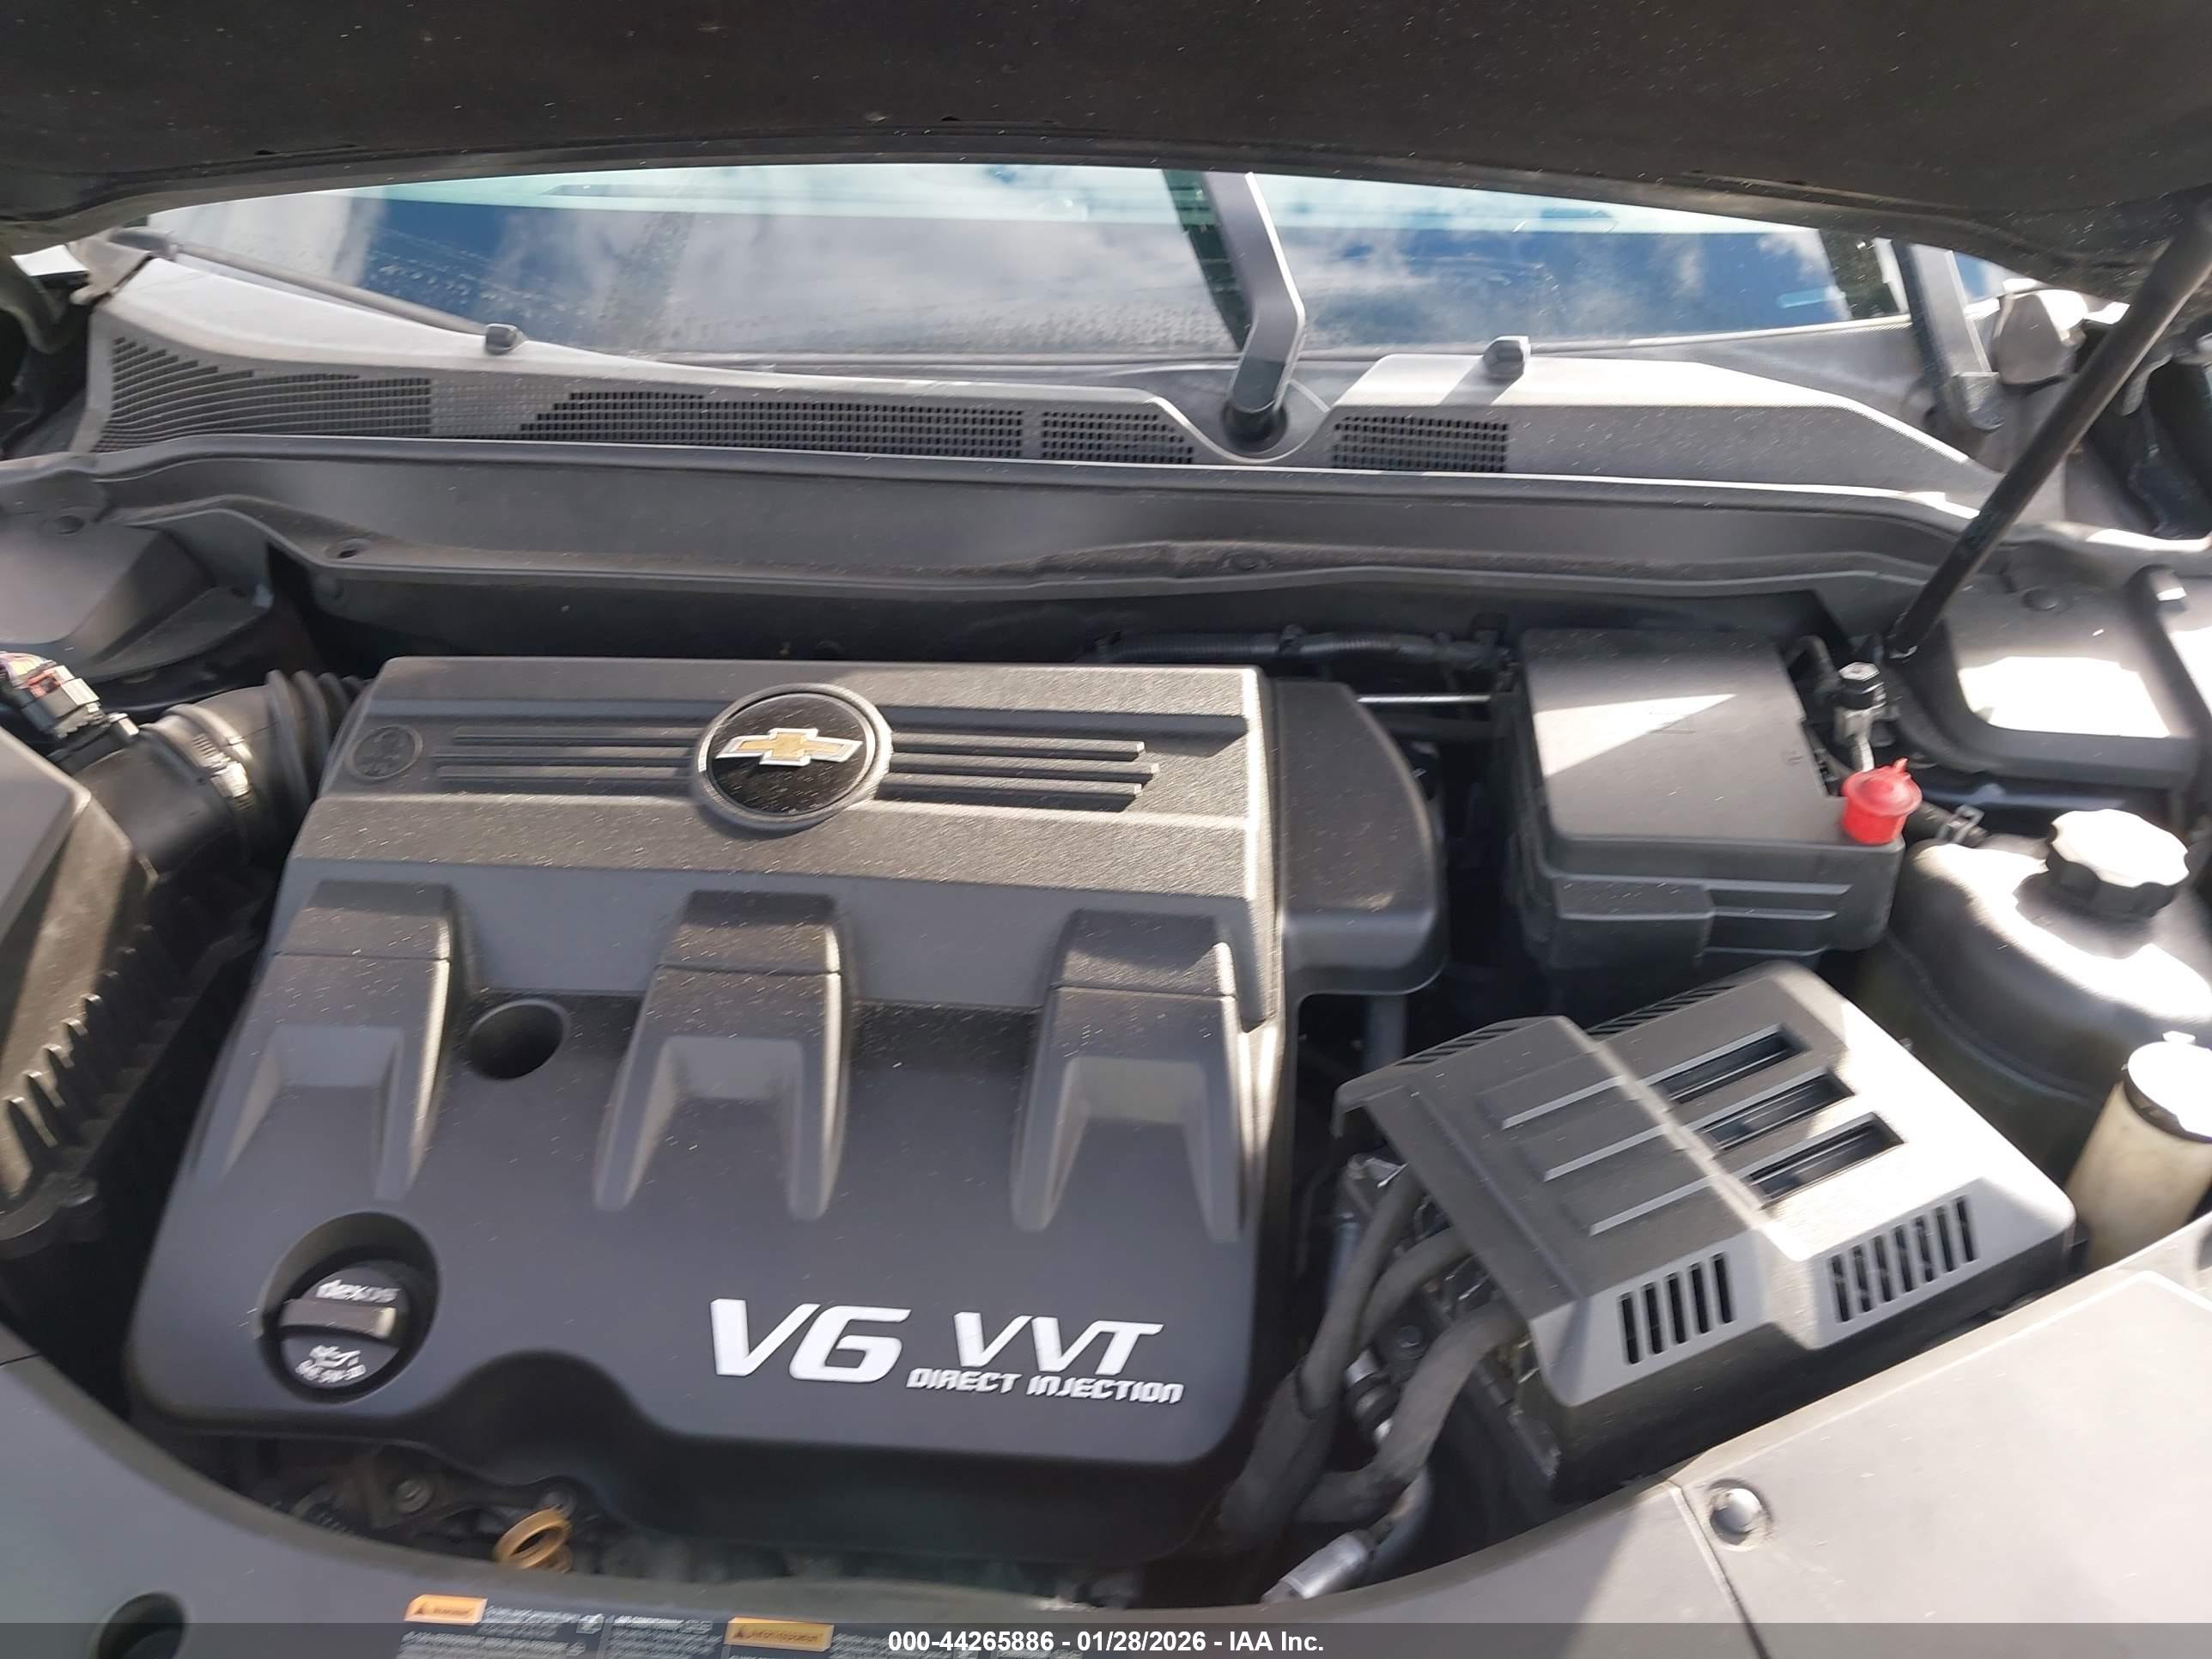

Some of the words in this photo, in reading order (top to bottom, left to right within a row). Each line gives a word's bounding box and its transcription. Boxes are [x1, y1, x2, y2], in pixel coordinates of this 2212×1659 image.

[709, 1297, 912, 1383] V6
[953, 1311, 1165, 1376] VVT
[906, 1367, 1023, 1394] DIRECT
[1025, 1375, 1184, 1405] INJECTION
